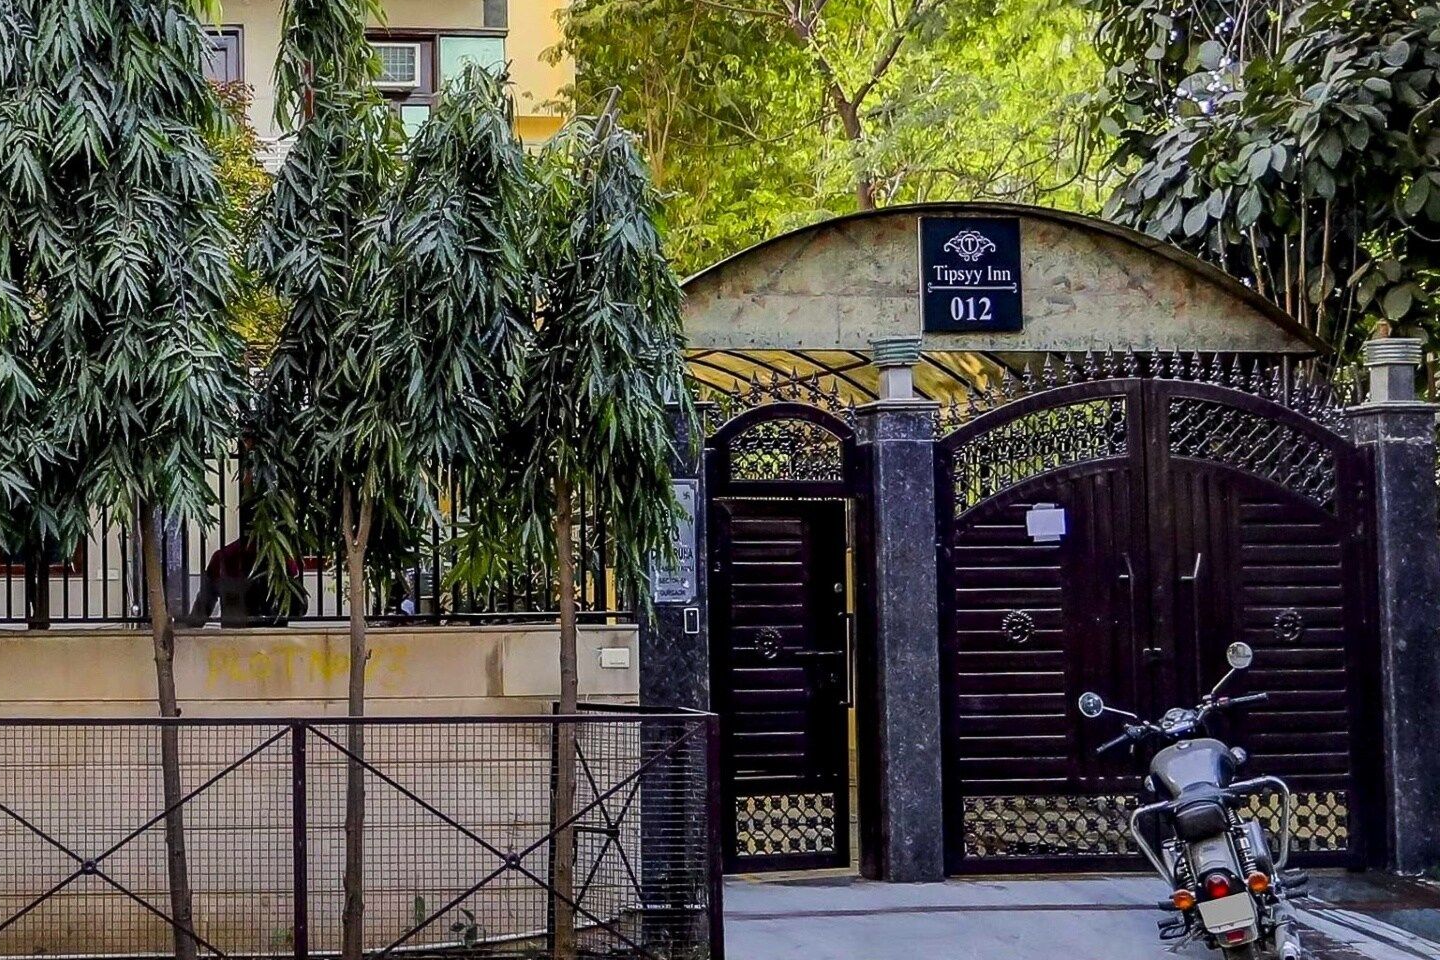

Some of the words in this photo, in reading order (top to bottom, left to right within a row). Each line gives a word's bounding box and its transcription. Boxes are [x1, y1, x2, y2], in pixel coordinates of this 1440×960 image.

[932, 264, 983, 285] Tipsyy
[987, 265, 1011, 281] Inn
[950, 296, 992, 321] 012
